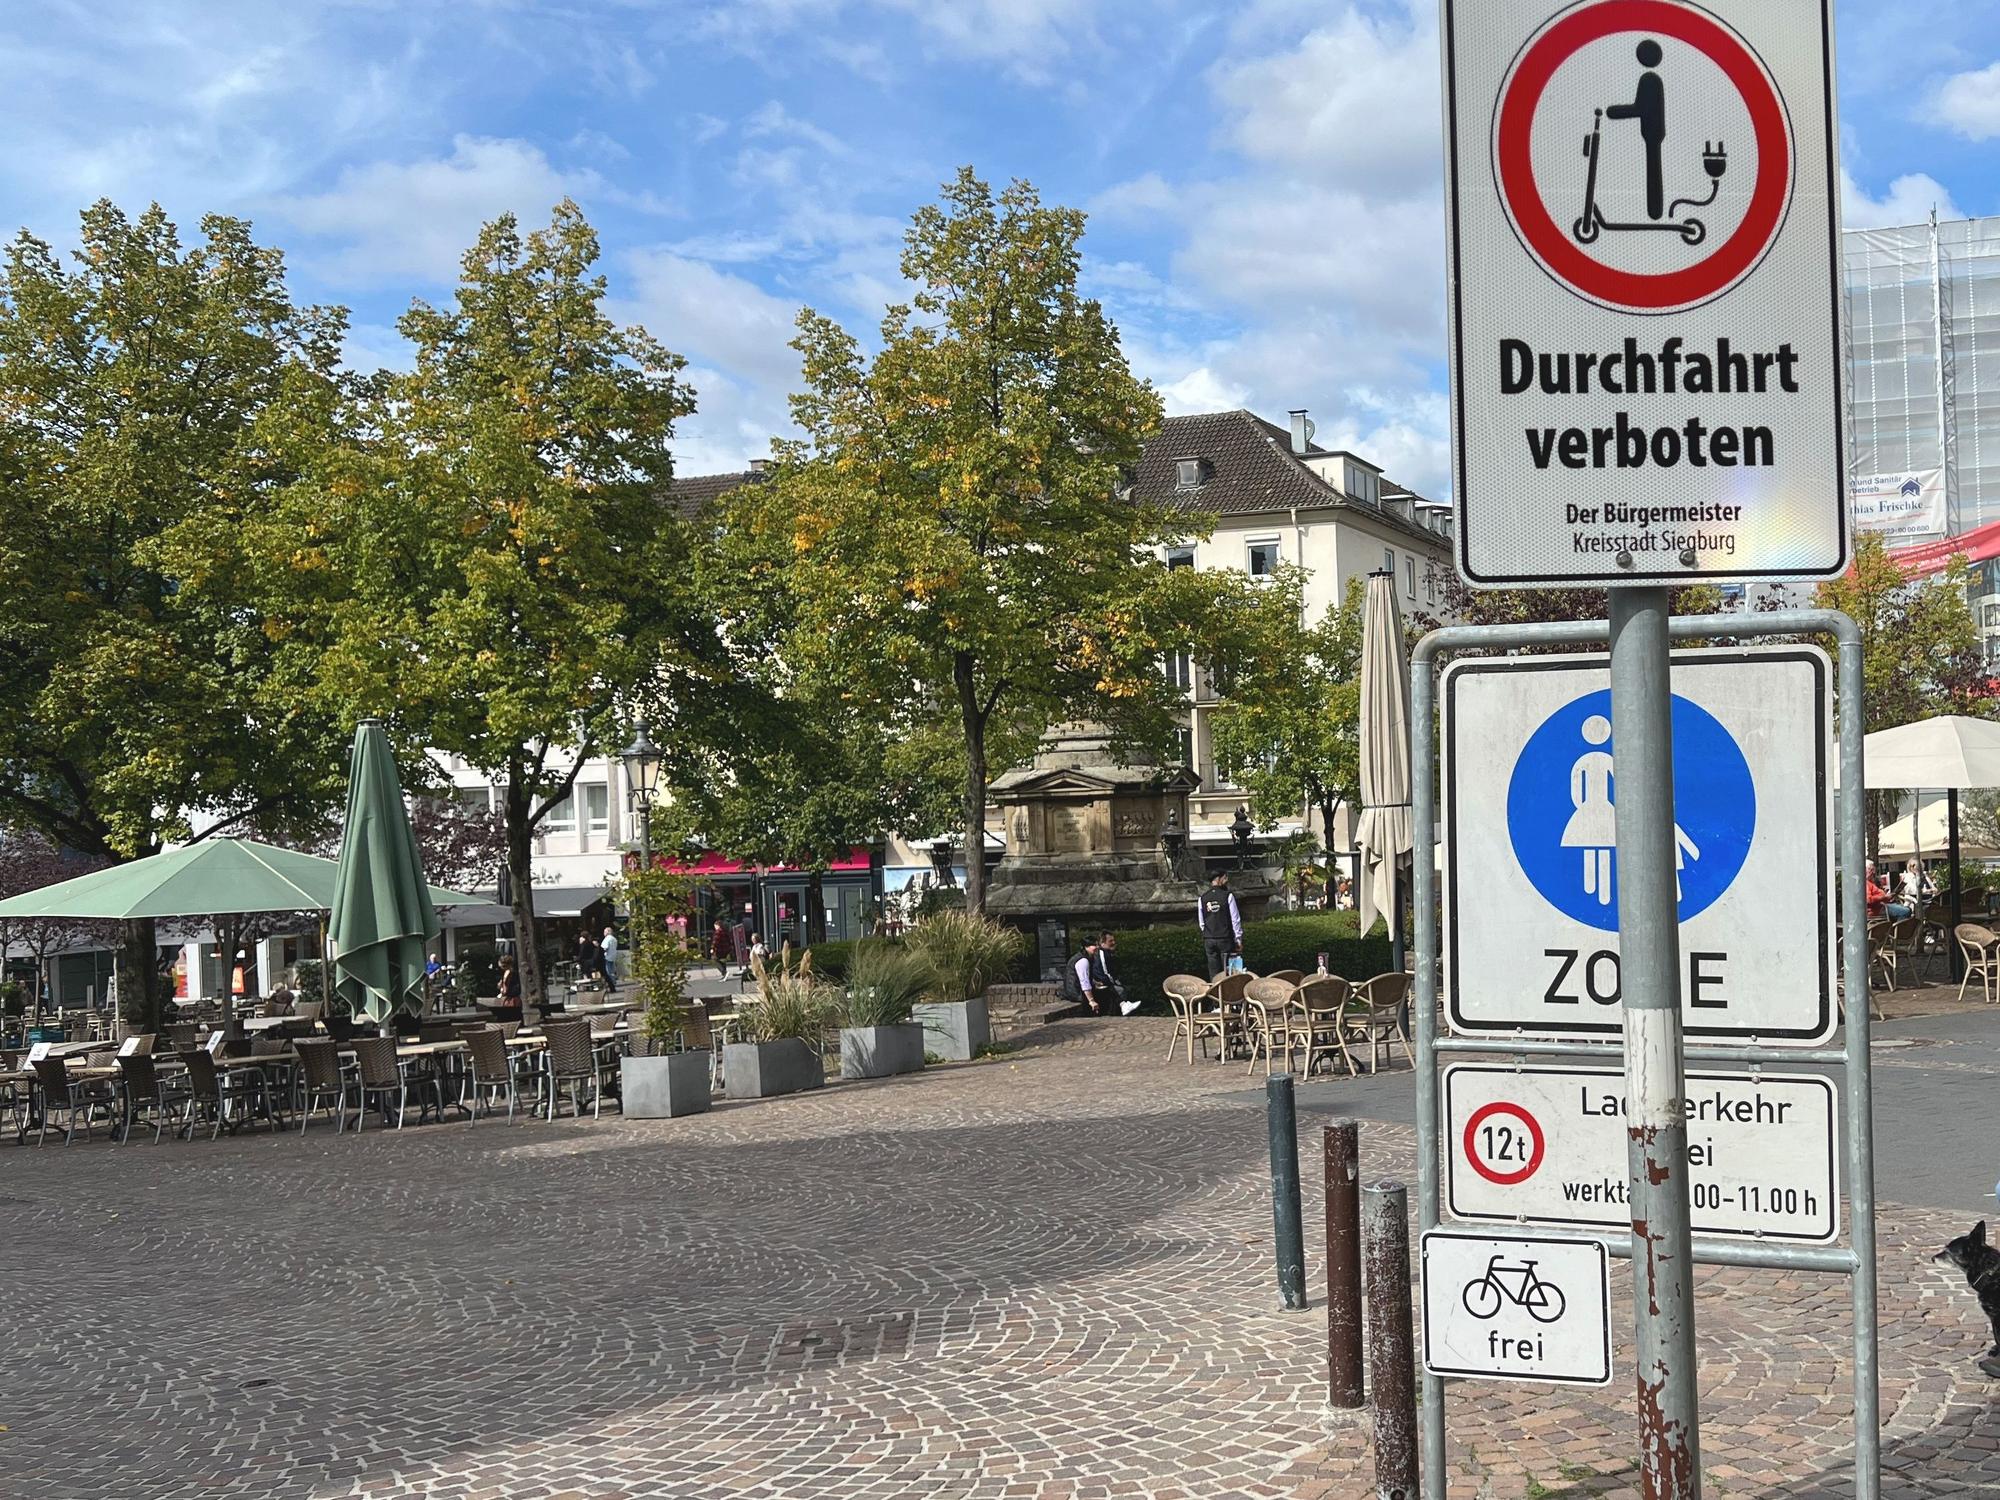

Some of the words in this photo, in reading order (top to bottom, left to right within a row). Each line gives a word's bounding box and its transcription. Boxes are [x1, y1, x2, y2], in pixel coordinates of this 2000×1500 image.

[1500, 337, 1798, 394] Durchfahrt
[1525, 411, 1774, 469] verboten
[1566, 503, 1599, 524] Der
[1604, 501, 1742, 528] Bürgermeister
[1879, 499, 1923, 513] Frischke
[1573, 531, 1657, 553] Kreisstadt
[1661, 529, 1735, 555] Siegburg
[1544, 948, 1728, 1009] ZOE
[1581, 1086, 1792, 1124] Laerkehr
[1804, 1189, 1817, 1216] h
[1488, 1330, 1543, 1361] frei
